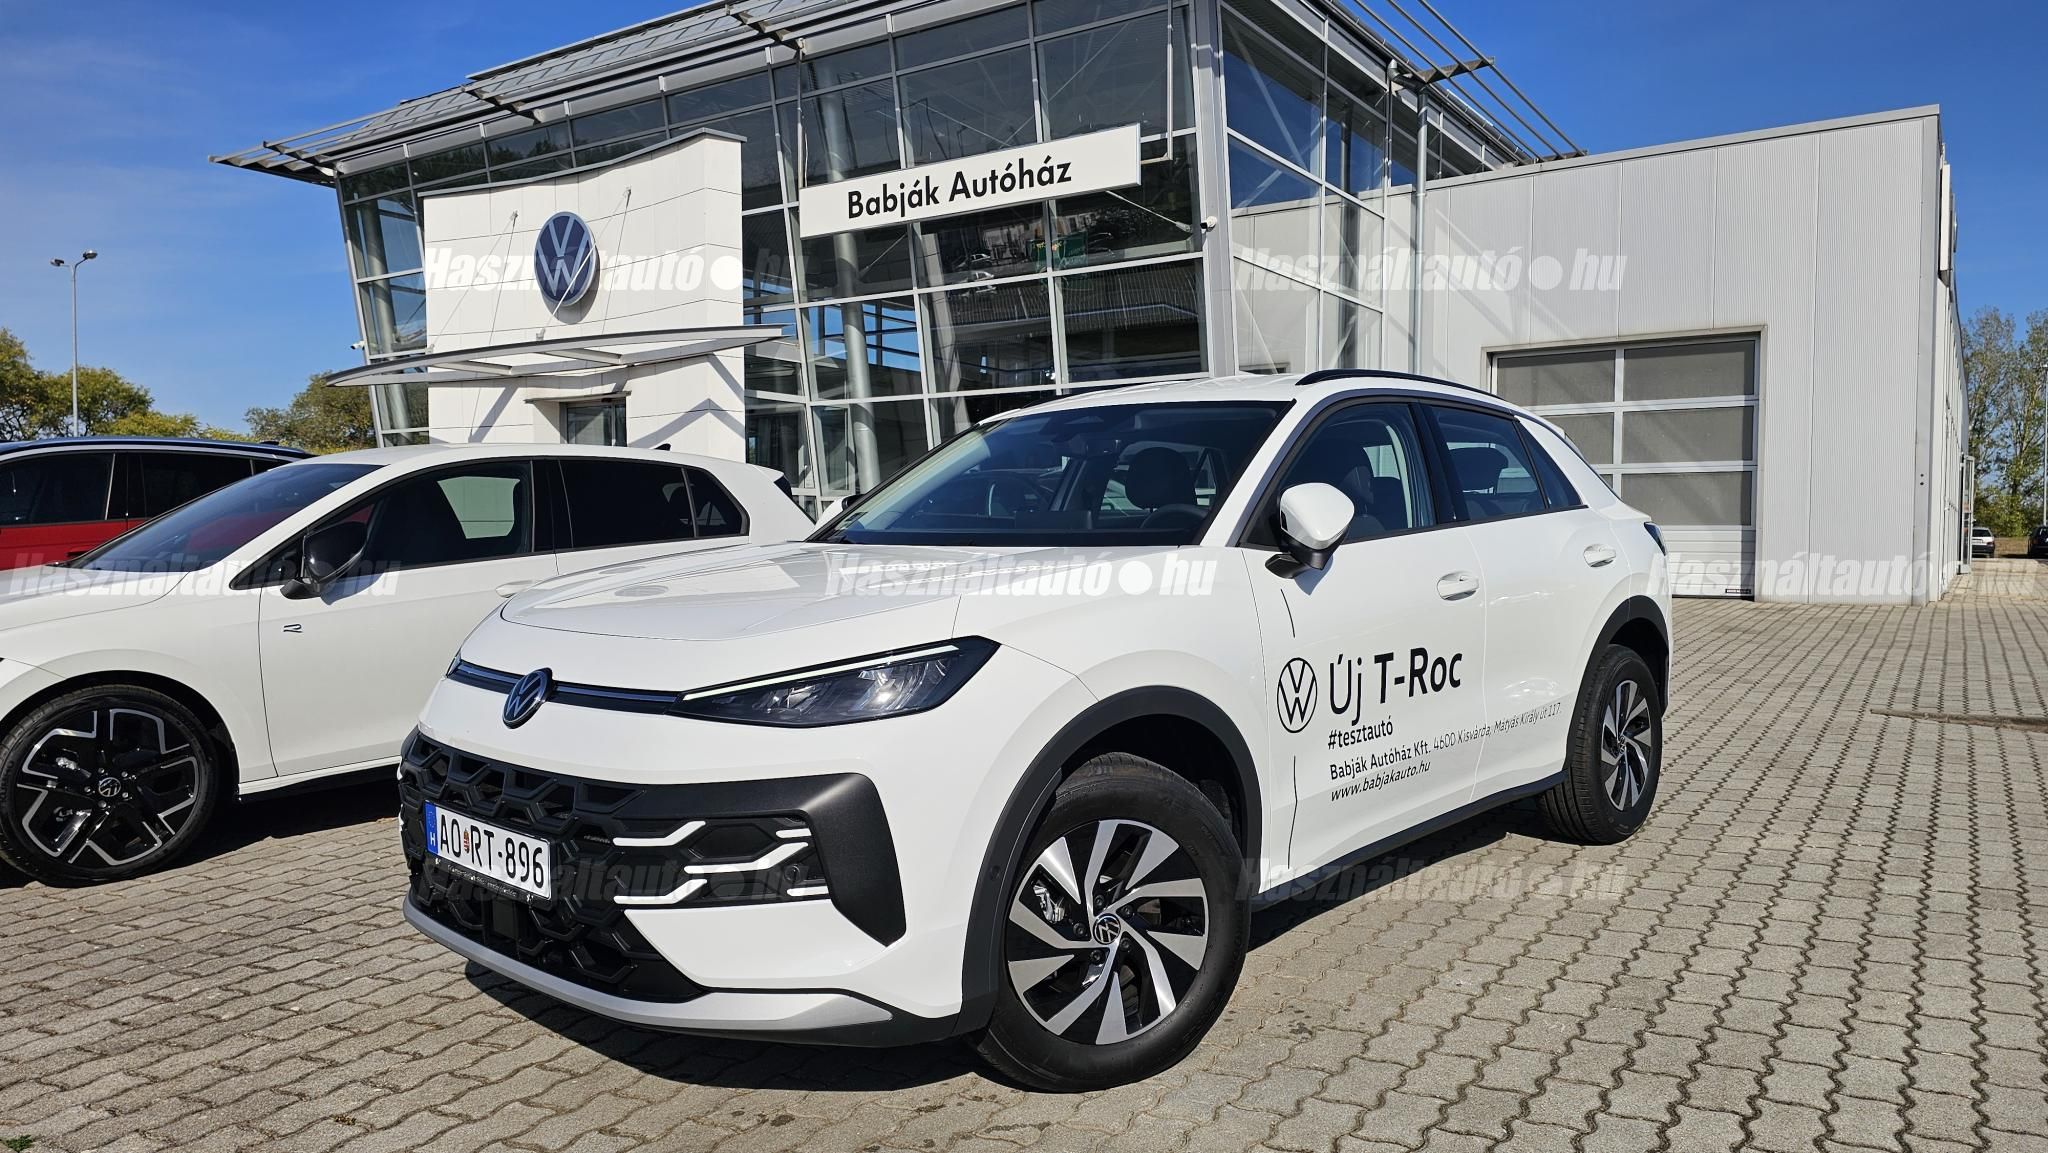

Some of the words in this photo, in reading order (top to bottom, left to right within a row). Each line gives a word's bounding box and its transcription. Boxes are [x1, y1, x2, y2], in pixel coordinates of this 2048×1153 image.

[848, 175, 940, 219] Babják
[949, 155, 1072, 202] Autóház
[1329, 653, 1362, 726] Új
[1373, 647, 1463, 704] T-Roc
[1328, 715, 1394, 750] #tesztautó
[1330, 756, 1368, 780] Babják
[1370, 745, 1412, 770] Autóház
[1414, 740, 1431, 758] Kft.
[1433, 732, 1456, 751] 4600
[1457, 724, 1492, 745] Kisvárda,
[1494, 715, 1520, 734] Mátyás
[1520, 709, 1539, 726] Király
[1539, 705, 1548, 720] út
[1331, 760, 1431, 802] www.babjakauto.hu
